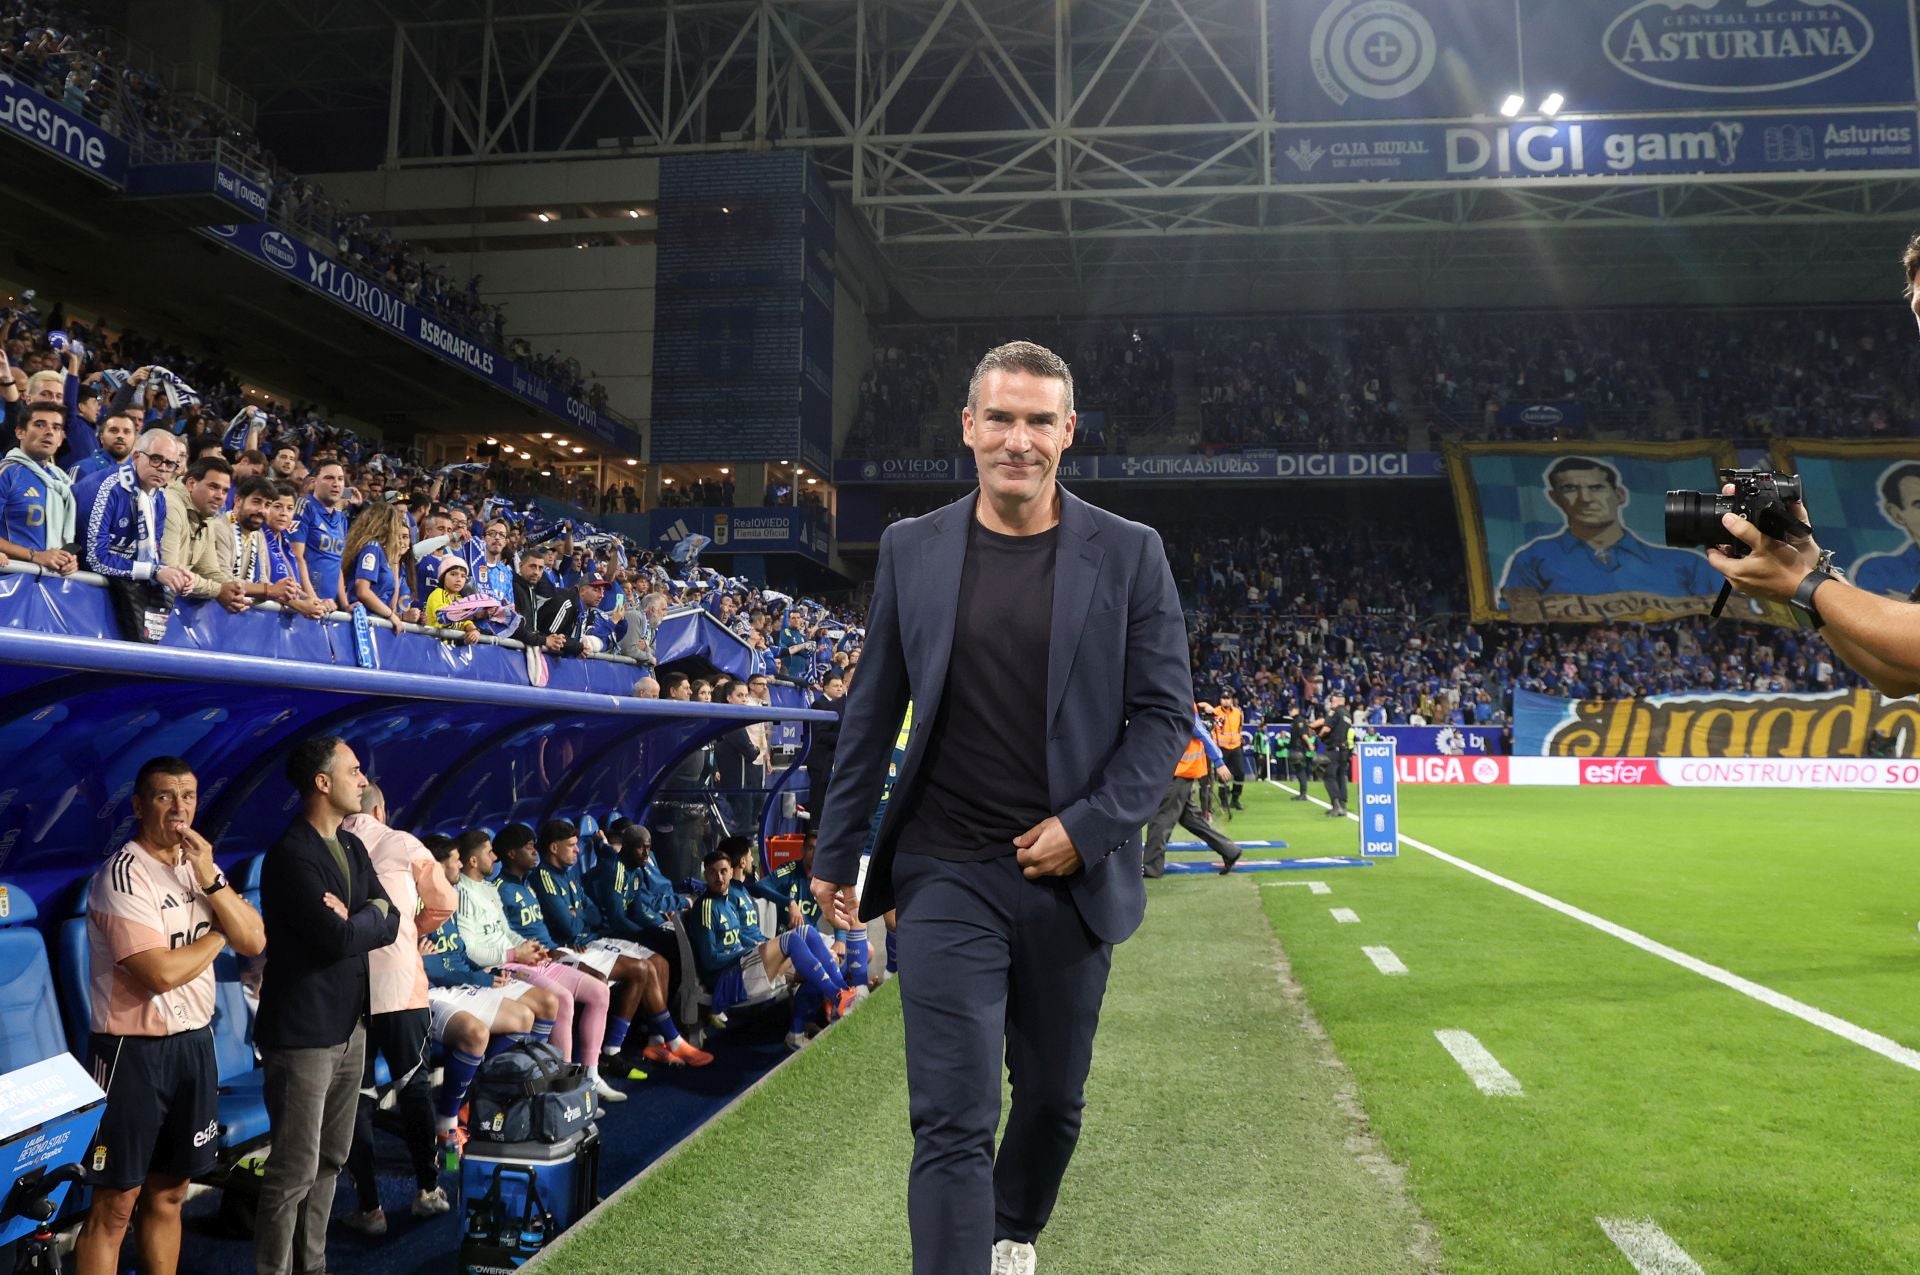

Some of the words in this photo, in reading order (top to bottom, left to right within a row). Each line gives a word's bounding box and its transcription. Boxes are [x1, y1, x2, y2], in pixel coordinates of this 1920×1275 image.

[1662, 13, 1748, 26] CENTRAL
[1754, 10, 1842, 24] LECHERA
[1621, 19, 1858, 62] ASTURIANA
[1823, 123, 1911, 144] Asturias
[1330, 142, 1370, 156] CAJA
[1373, 140, 1429, 154] RURAL
[1445, 125, 1583, 173] DIGI
[1604, 131, 1717, 169] gam
[217, 172, 233, 190] Real
[240, 185, 265, 210] OVIEDO
[328, 262, 407, 331] LOROMI
[420, 317, 494, 375] BSBGRAFICA.ES
[566, 397, 597, 428] copun
[883, 459, 949, 472] OVIEDO
[1056, 462, 1081, 477] ank
[1277, 454, 1336, 475] DIGI
[1349, 454, 1409, 475] DIGI
[735, 529, 762, 537] Tienda
[763, 528, 789, 538] Oficial
[1365, 746, 1389, 757] DIGI
[1396, 757, 1465, 783] LIGA
[1585, 761, 1646, 784] esfer
[1681, 762, 1877, 784] CONSTRUYENDO
[1366, 794, 1391, 805] DIGI
[1367, 842, 1392, 853] DIGI
[193, 1119, 219, 1148] esfe
